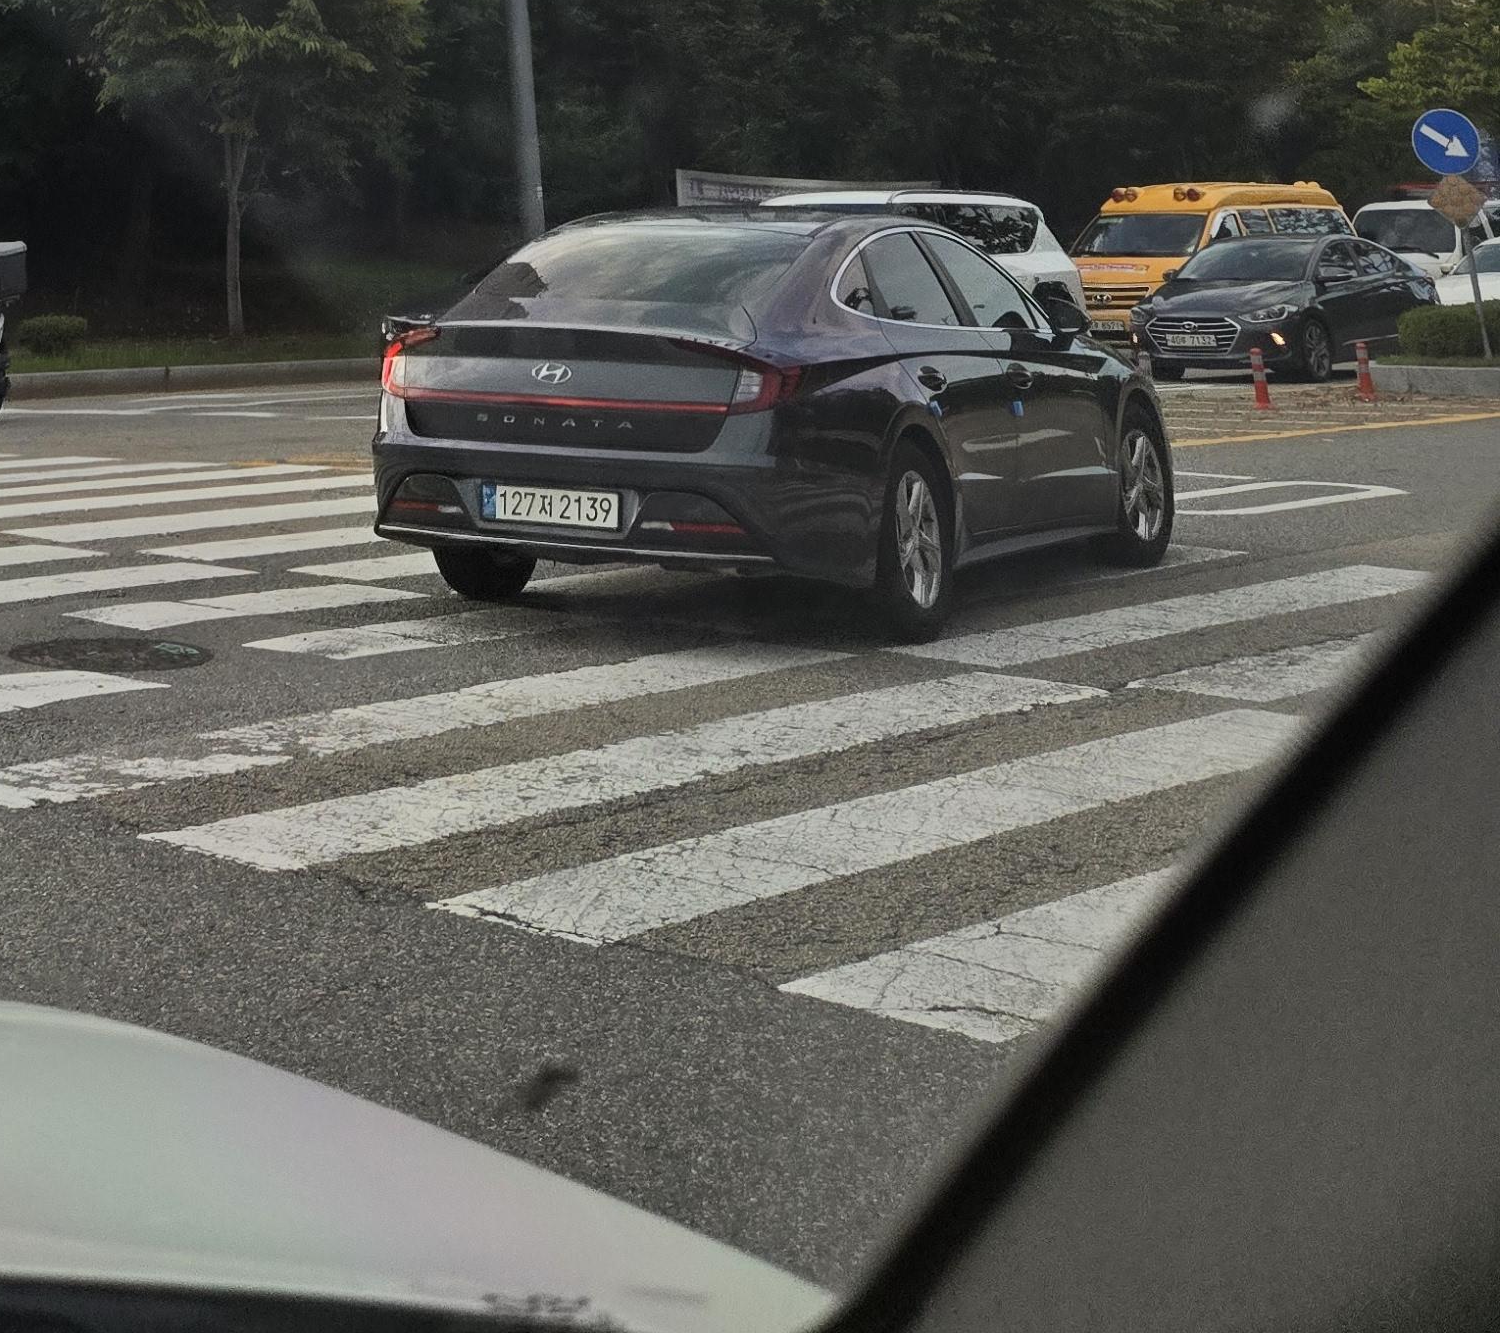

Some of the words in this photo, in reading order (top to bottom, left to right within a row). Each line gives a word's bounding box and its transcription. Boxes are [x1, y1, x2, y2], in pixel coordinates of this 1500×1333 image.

[475, 412, 633, 429] SONATA
[499, 489, 553, 518] 127저
[559, 494, 612, 523] 2139
